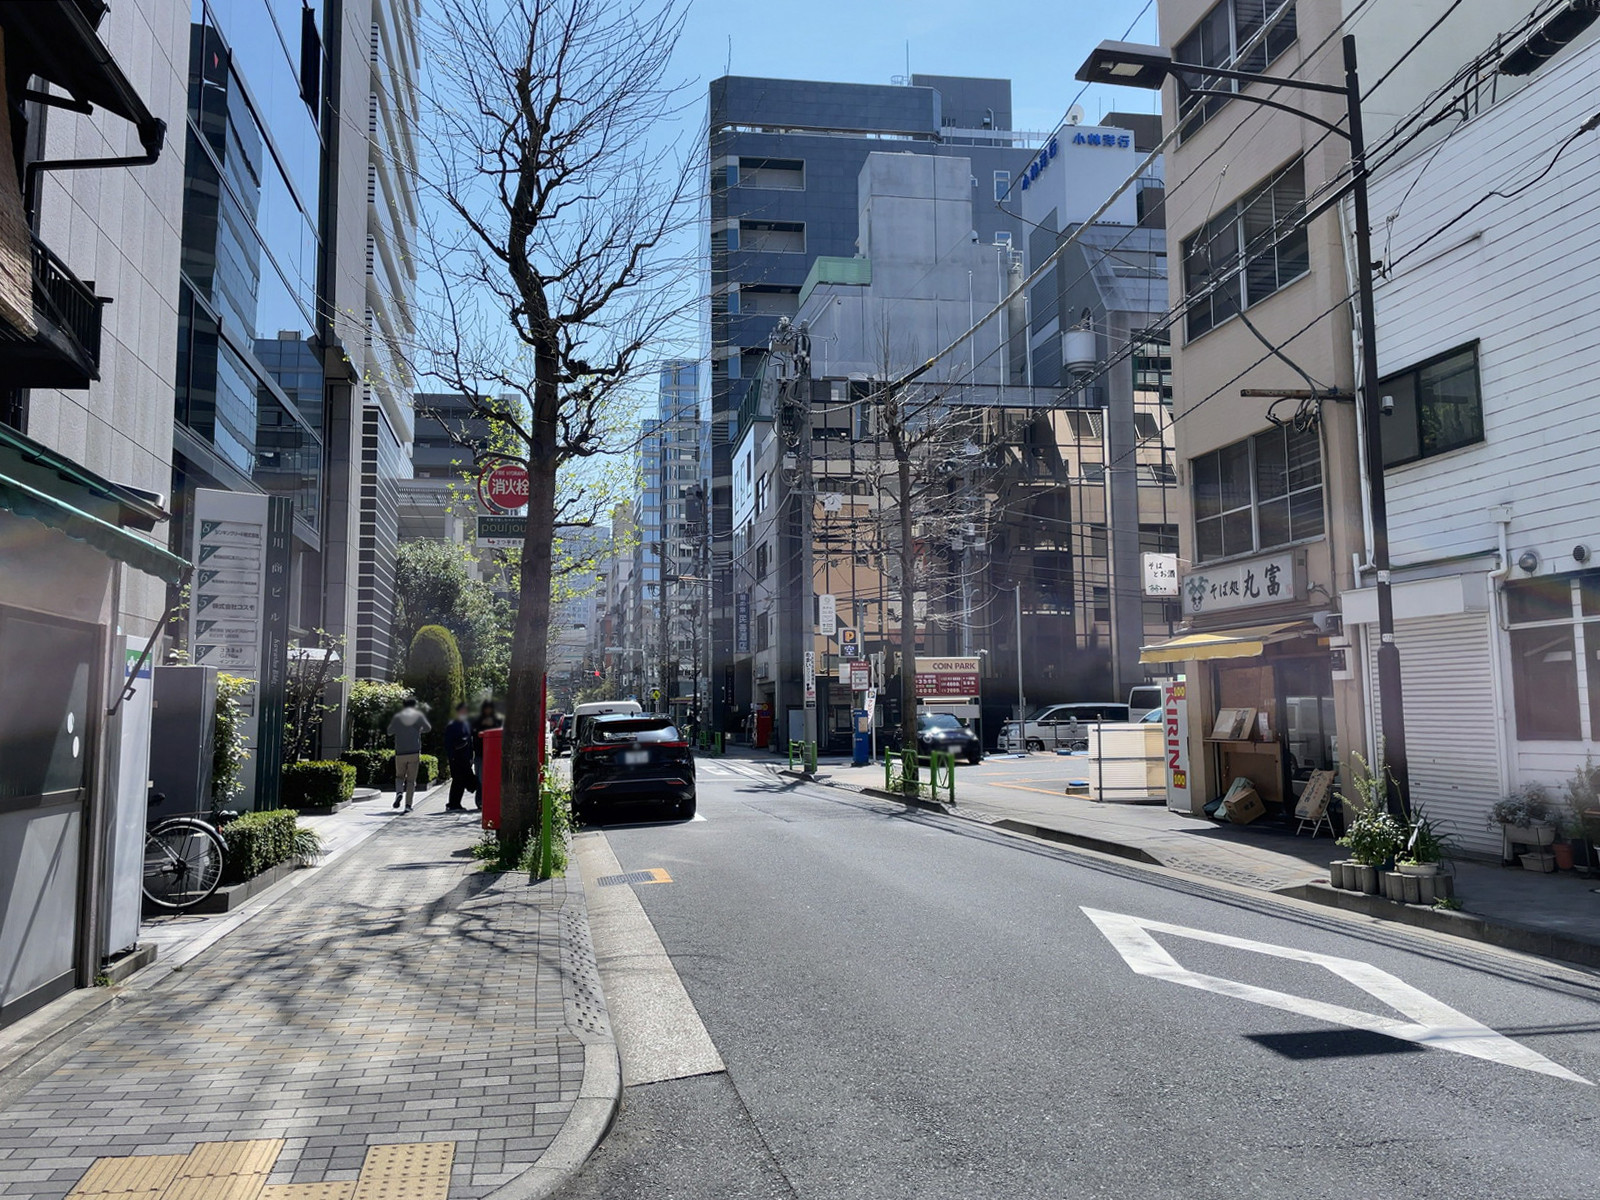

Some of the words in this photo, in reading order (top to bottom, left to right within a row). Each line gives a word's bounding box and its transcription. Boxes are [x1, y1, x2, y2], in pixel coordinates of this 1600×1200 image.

[1072, 132, 1131, 149] 小林洋行
[491, 478, 529, 495] 消火栓
[202, 522, 212, 533] 8
[202, 547, 211, 558] 7
[200, 571, 210, 583] 6
[198, 596, 209, 607] 5
[844, 630, 855, 642] P
[196, 646, 206, 658] 3
[1165, 687, 1180, 769] KIRIN
